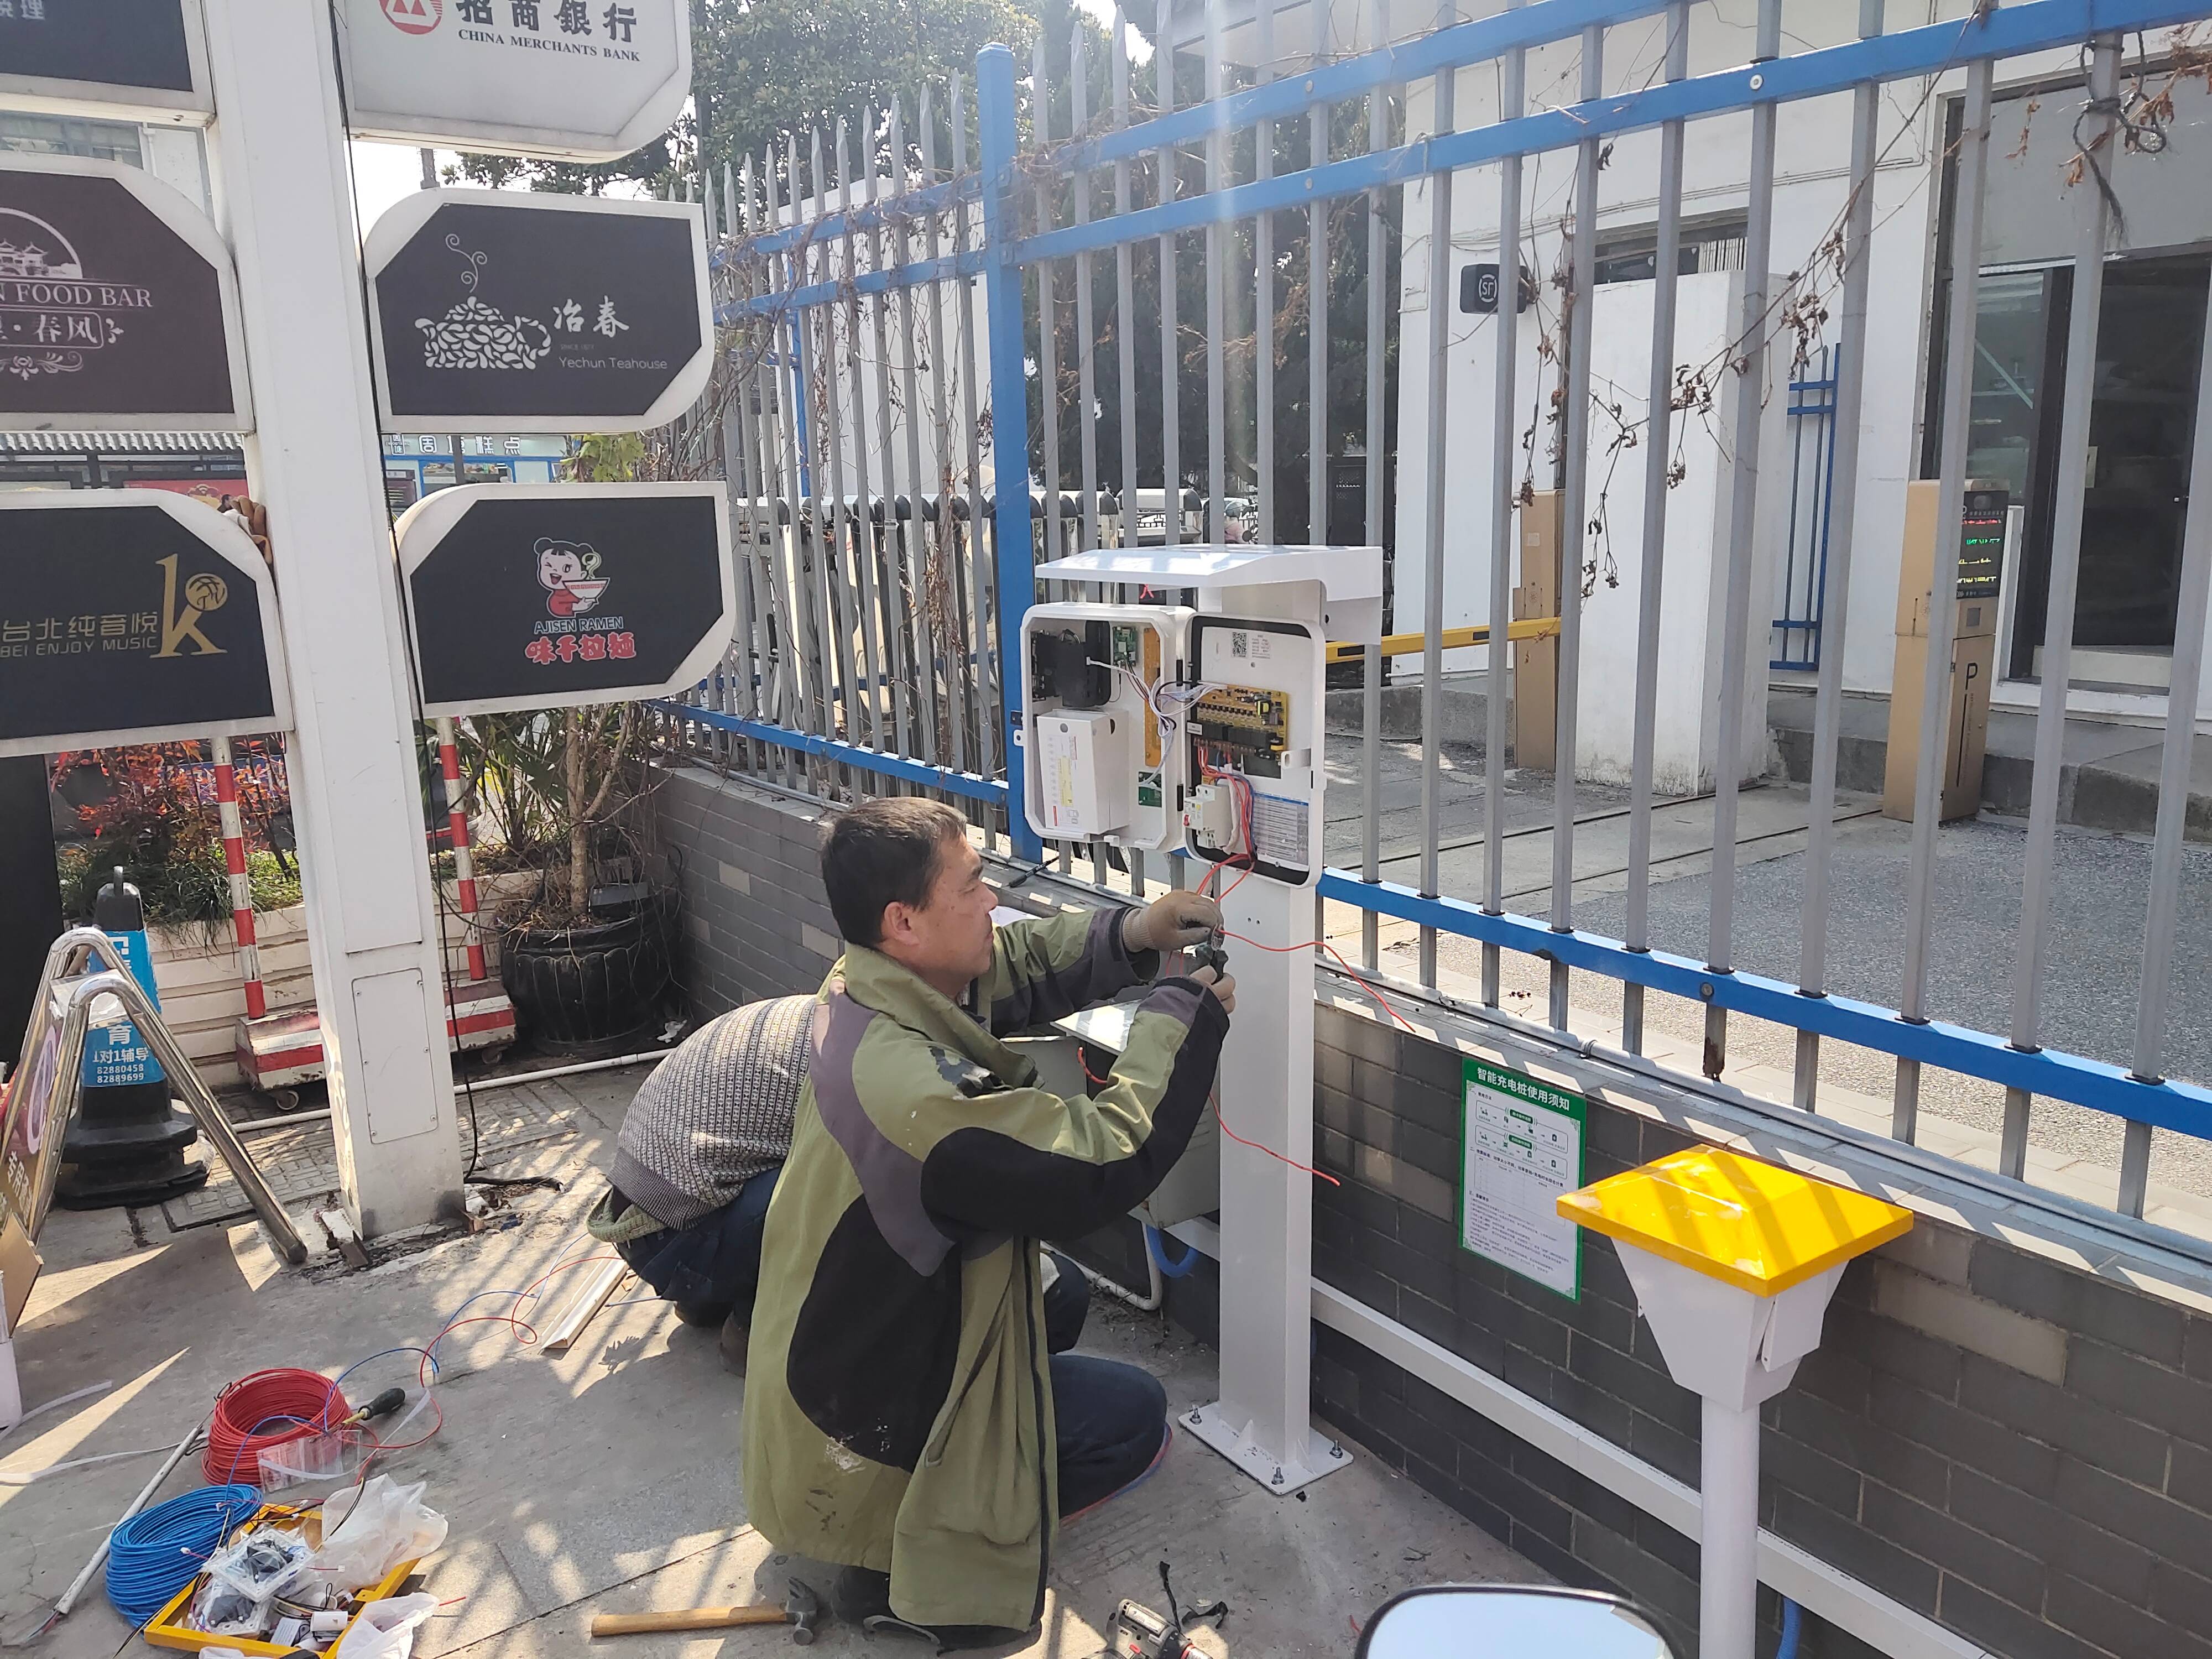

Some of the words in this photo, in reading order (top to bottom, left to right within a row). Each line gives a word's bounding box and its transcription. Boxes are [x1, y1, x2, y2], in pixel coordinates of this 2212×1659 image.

[458, 29, 504, 44] CHINA
[509, 35, 597, 56] MERCHANTS
[603, 48, 640, 62] BANK
[17, 282, 92, 305] FOOD
[100, 286, 153, 308] BAR
[558, 357, 606, 368] Yechun
[608, 357, 668, 369] Teahouse
[2, 611, 158, 642] 台北纯音悦
[534, 618, 577, 634] AJISEN
[578, 615, 624, 632] RAMEN
[36, 640, 95, 656] ENJOY
[103, 636, 158, 651] MUSIC
[1965, 662, 1978, 691] P
[93, 1047, 149, 1063] 1对1辅导
[97, 1064, 144, 1074] 82880458
[97, 1073, 144, 1083] 82889699
[1477, 1067, 1570, 1112] 智能充电桩使用须知
